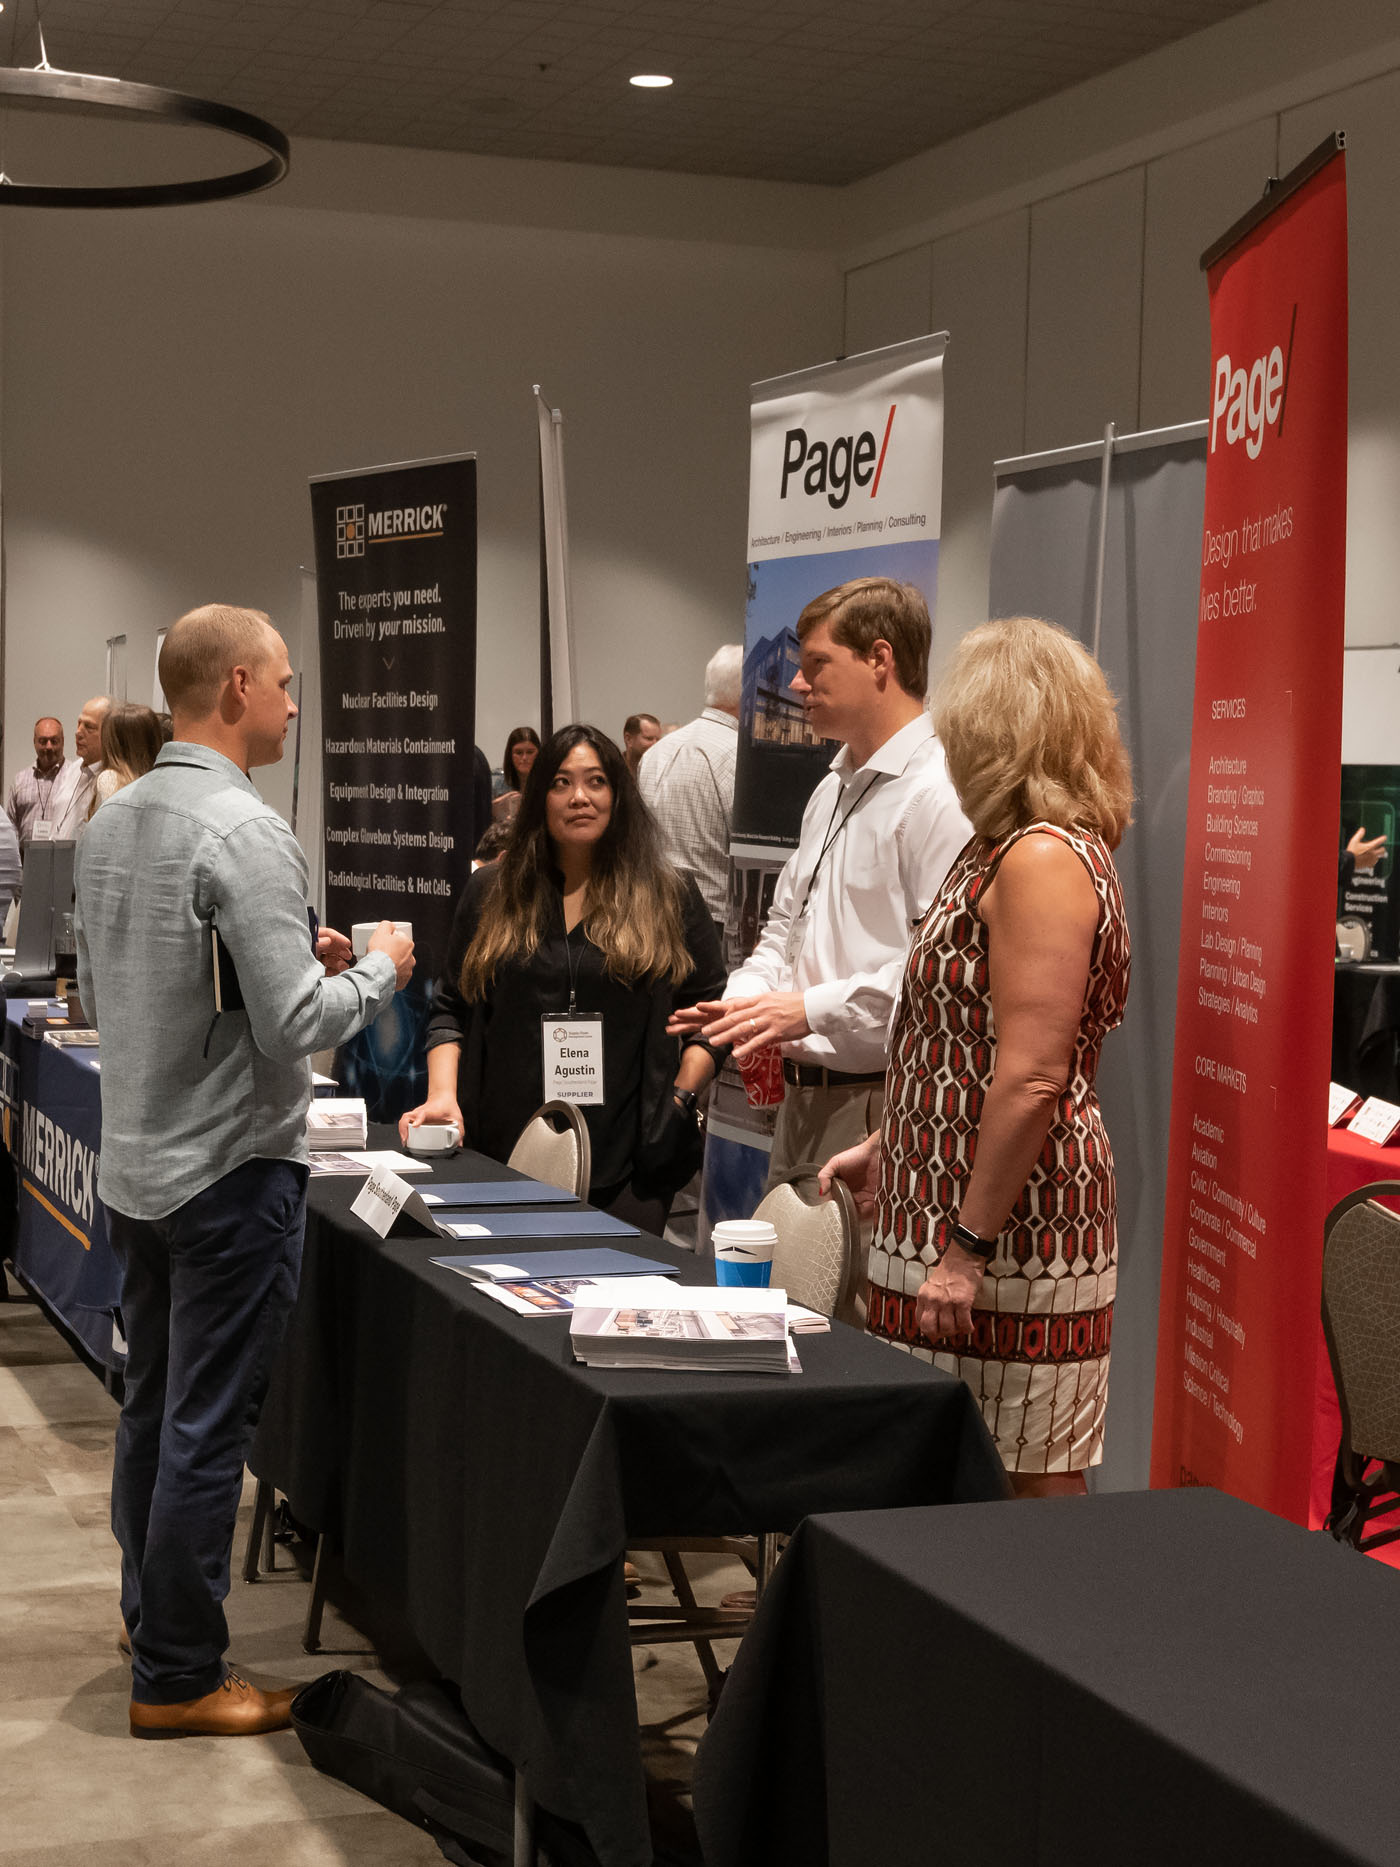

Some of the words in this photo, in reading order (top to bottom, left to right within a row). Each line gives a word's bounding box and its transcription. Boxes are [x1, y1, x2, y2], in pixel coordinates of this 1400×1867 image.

[368, 504, 444, 536] MERRICK
[785, 527, 822, 545] Engineering
[827, 524, 852, 538] Interiors
[857, 519, 884, 534] Planning
[888, 513, 926, 528] Consulting
[1203, 525, 1239, 568] Design
[1242, 513, 1262, 553] that
[1263, 503, 1293, 547] makes
[339, 591, 356, 611] The
[358, 590, 391, 613] experts
[393, 590, 411, 612] you
[414, 583, 441, 605] need.
[1223, 578, 1257, 616] better.
[334, 619, 364, 639] Driven
[365, 618, 376, 642] by
[378, 619, 402, 641] your
[403, 613, 446, 635] mission.
[342, 693, 371, 709] Nuclear
[372, 691, 408, 708] Facilities
[409, 690, 438, 711] Design
[1212, 698, 1246, 720] SERVICES
[325, 738, 366, 754] Hazardous
[366, 738, 401, 754] Materials
[403, 737, 456, 754] Containment
[1209, 756, 1247, 774] Architecture
[330, 782, 369, 802] Equipment
[370, 783, 396, 803] Design
[397, 783, 404, 800] &
[405, 784, 449, 805] Integration
[1207, 785, 1237, 809] Branding
[1241, 785, 1265, 807] Graphics
[326, 826, 359, 846] Complex
[360, 827, 391, 845] Glovebox
[393, 829, 427, 850] Systems
[428, 831, 454, 853] Design
[1206, 814, 1232, 839] Building
[1233, 815, 1259, 836] Sciences
[1205, 842, 1252, 871] Commissioning
[328, 870, 371, 892] Radiological
[372, 874, 406, 893] Facilities
[407, 876, 415, 893] &
[416, 877, 432, 895] Hot
[432, 878, 451, 897] Cells
[1203, 871, 1241, 900] Engineering
[1202, 900, 1229, 922] Interiors
[1201, 928, 1213, 949] Lab
[1215, 931, 1237, 959] Design
[1241, 937, 1262, 968] Planning
[1200, 957, 1228, 987] Planning
[1232, 965, 1250, 989] Urban
[1250, 970, 1266, 999] Design
[1199, 986, 1230, 1015] Strategies
[1235, 997, 1258, 1025] Analytics
[560, 1048, 589, 1058] Elena
[555, 1065, 595, 1078] Agustin
[1195, 1056, 1216, 1080] CORE
[1217, 1063, 1247, 1094] MARKETS
[1193, 1113, 1225, 1143] Academic
[23, 1100, 95, 1227] MERRICK
[1192, 1142, 1218, 1170] Aviation
[1191, 1170, 1207, 1195] Civic
[1212, 1181, 1244, 1222] Community
[1248, 1203, 1266, 1235] Culture
[1190, 1199, 1221, 1233] Corporate
[1225, 1219, 1256, 1260] Commercial
[1188, 1227, 1226, 1267] Government
[1187, 1256, 1220, 1293] Healthcare
[1185, 1313, 1214, 1349] Industrial
[1186, 1284, 1212, 1322] Housing
[1216, 1305, 1246, 1350] Hospitality
[1184, 1342, 1208, 1376] Mission
[1208, 1361, 1229, 1394] Critical
[1183, 1370, 1208, 1406] Science
[1212, 1393, 1243, 1445] Technology
